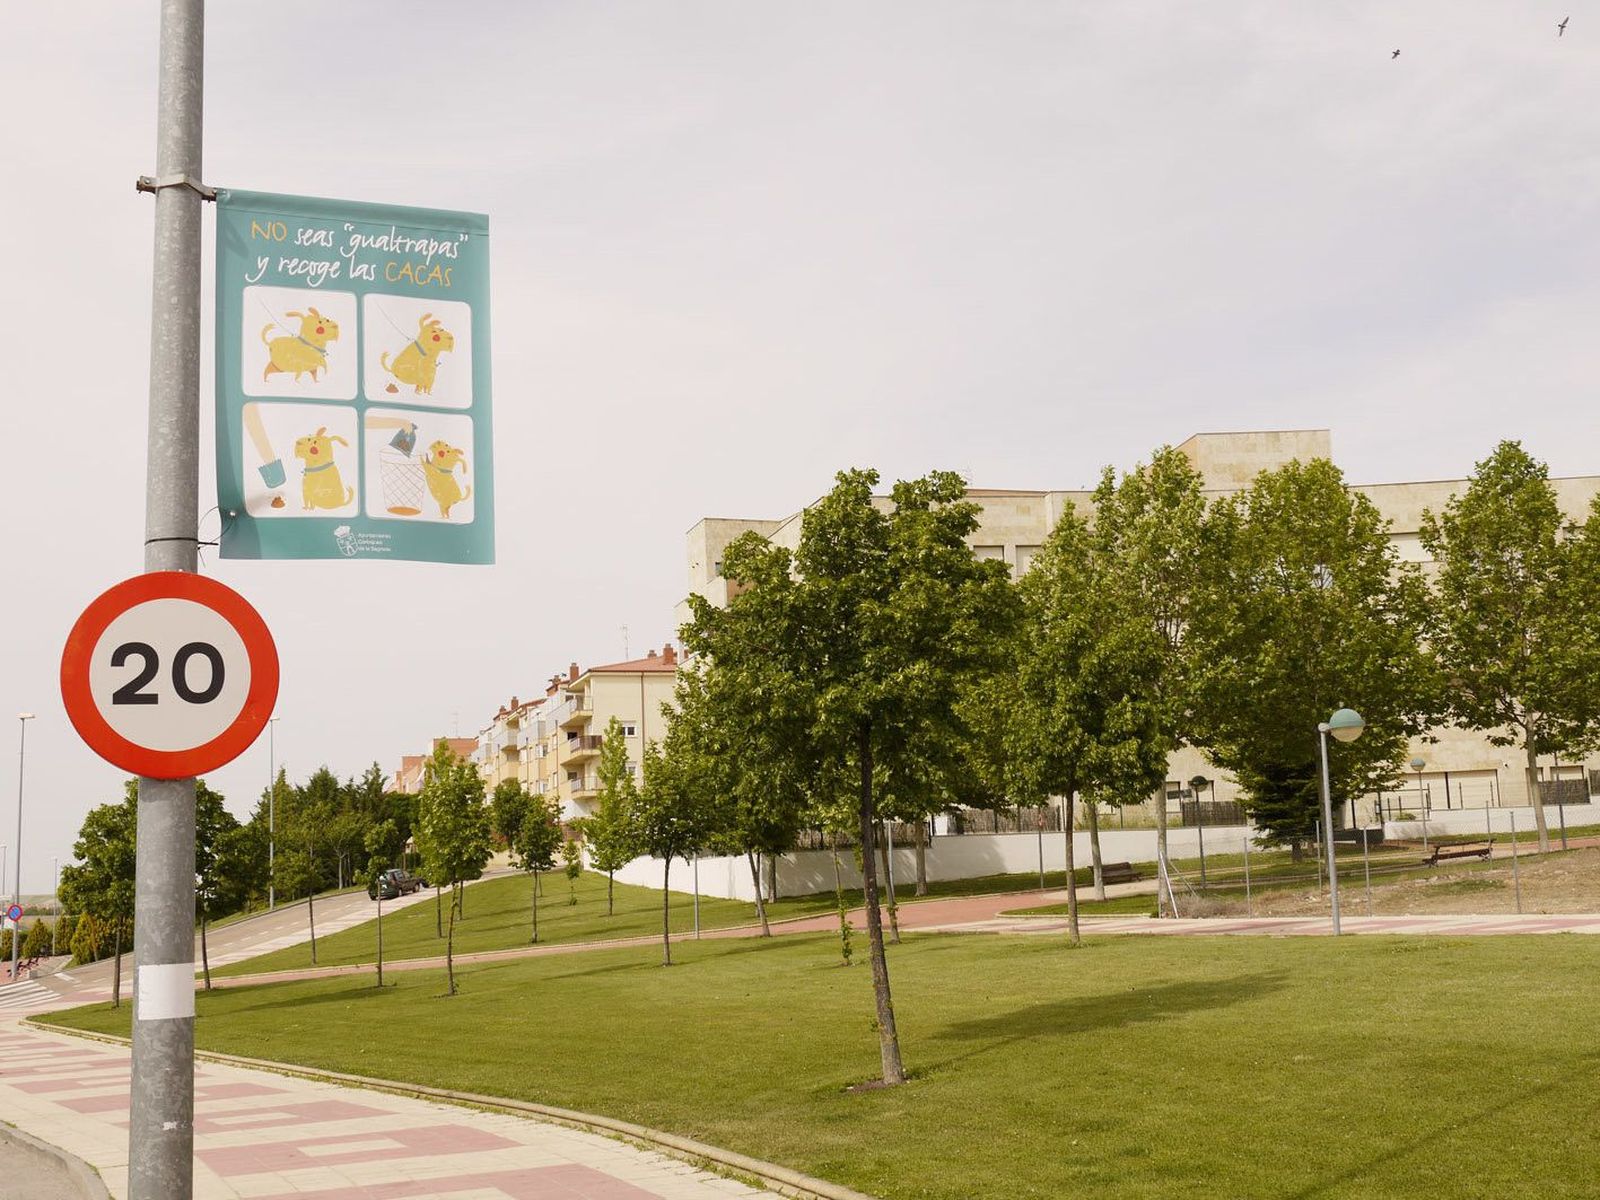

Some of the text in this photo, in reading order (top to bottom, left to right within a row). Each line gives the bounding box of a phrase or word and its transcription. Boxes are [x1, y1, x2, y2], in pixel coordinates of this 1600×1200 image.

[251, 220, 287, 242] NO
[294, 227, 335, 247] seas
[245, 256, 453, 288] y recoge las CACAS
[110, 641, 226, 705] 20
